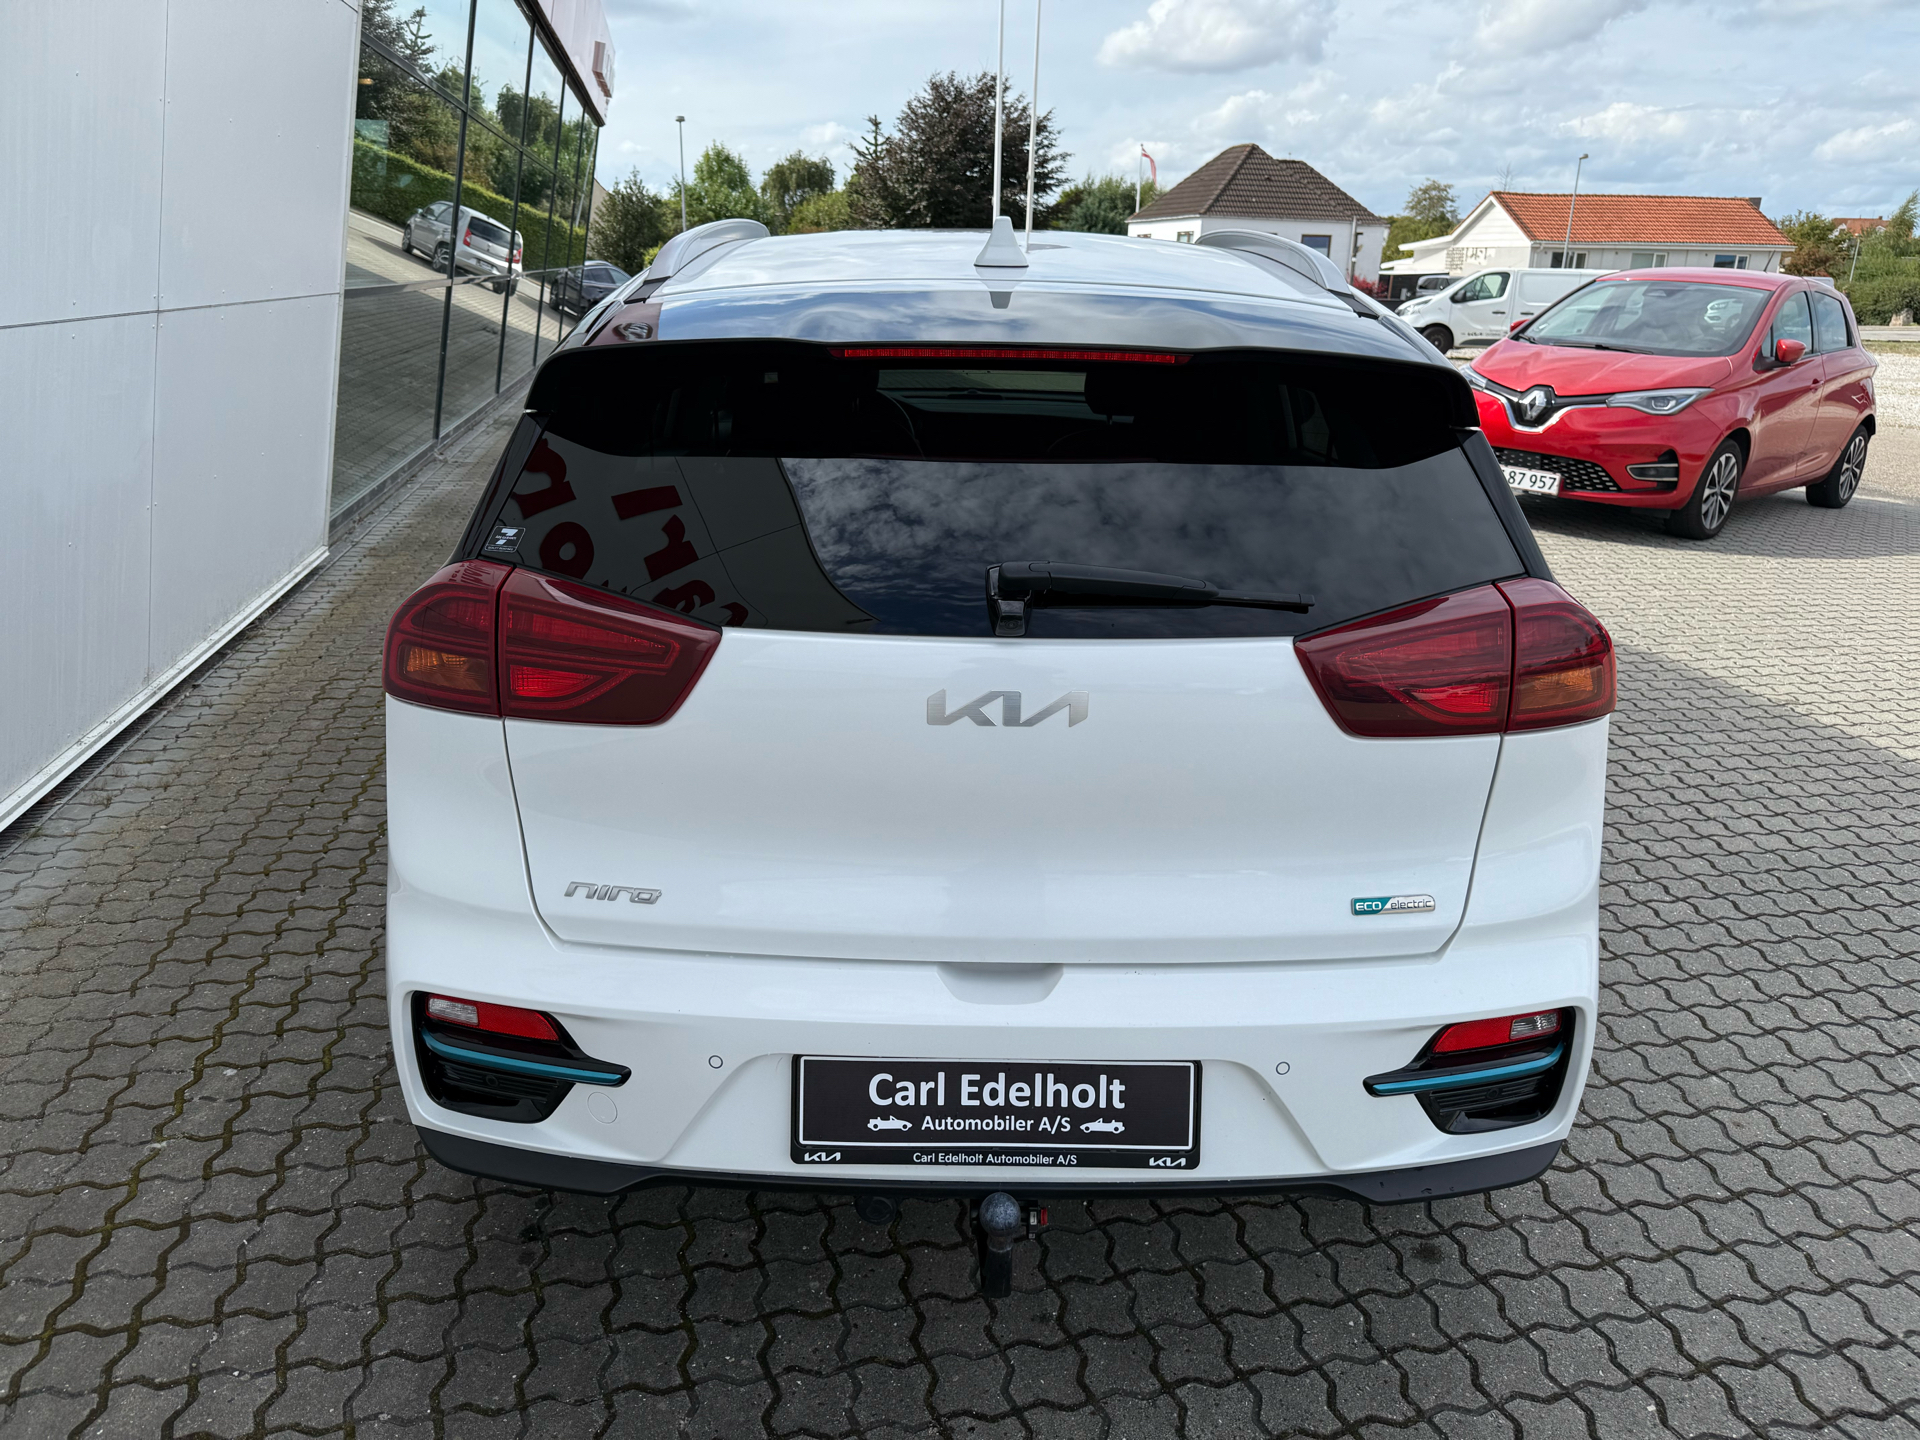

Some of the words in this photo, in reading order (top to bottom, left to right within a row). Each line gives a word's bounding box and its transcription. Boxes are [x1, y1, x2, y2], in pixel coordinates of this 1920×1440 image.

[1508, 470, 1526, 485] 87
[1529, 474, 1557, 490] 957
[926, 688, 1089, 728] KIA
[1355, 901, 1382, 911] ECO
[1390, 898, 1432, 910] electric
[868, 1071, 945, 1106] Carl
[960, 1071, 1126, 1109] Edelholt
[921, 1115, 1034, 1132] Automobiler
[1038, 1115, 1071, 1134] A/S
[804, 1152, 841, 1162] KIA
[913, 1152, 935, 1163] Carl
[938, 1152, 984, 1164] Edelholt
[986, 1153, 1054, 1165] Automobiler
[1056, 1154, 1077, 1166] A/S
[1149, 1157, 1186, 1167] KIA
